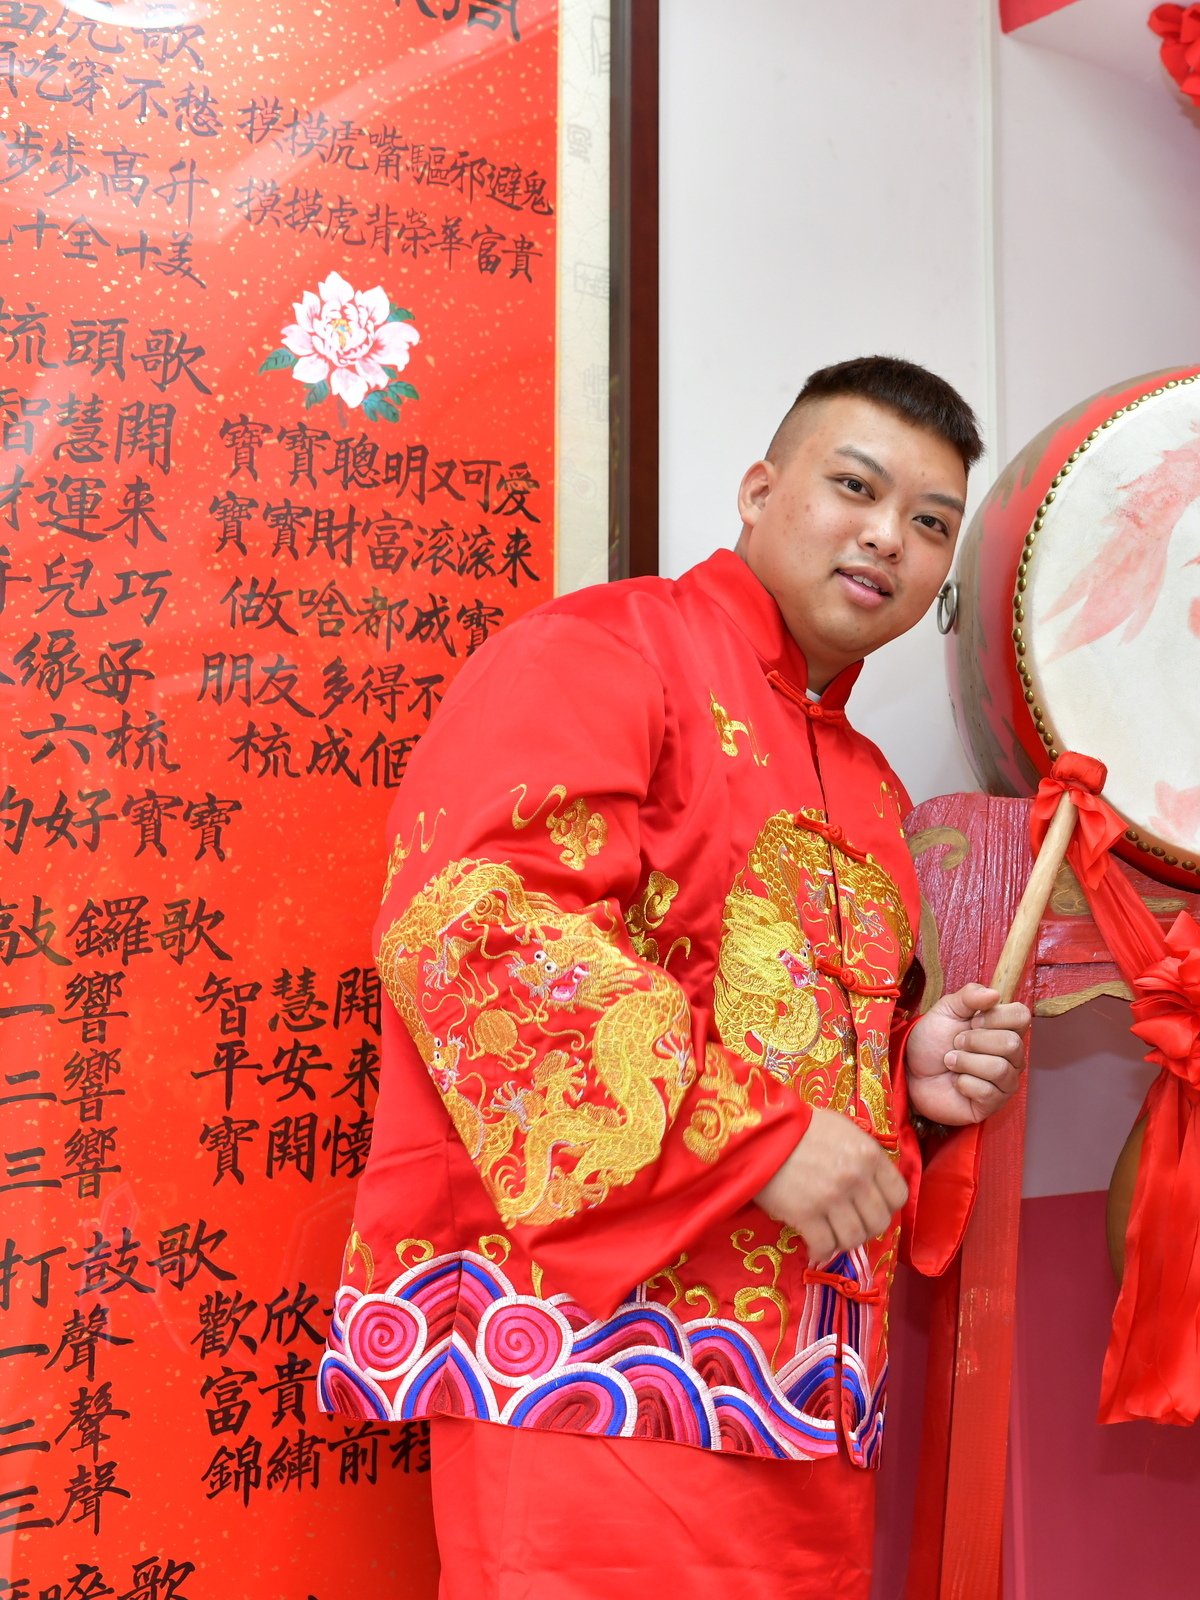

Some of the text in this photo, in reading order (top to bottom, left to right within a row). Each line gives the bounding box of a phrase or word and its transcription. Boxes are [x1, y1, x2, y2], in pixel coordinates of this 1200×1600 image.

[236, 95, 553, 216] 摸摸虎嘴驅邪避鬼
[0, 207, 207, 289] 十全十美
[232, 174, 543, 284] 摸摸虎背榮華富貴
[0, 628, 156, 706] 緣好
[20, 709, 182, 774] 六梳
[0, 1219, 237, 1311] 打鼓歌
[190, 1282, 334, 1360] 歡欣
[200, 1352, 334, 1437] 富貴
